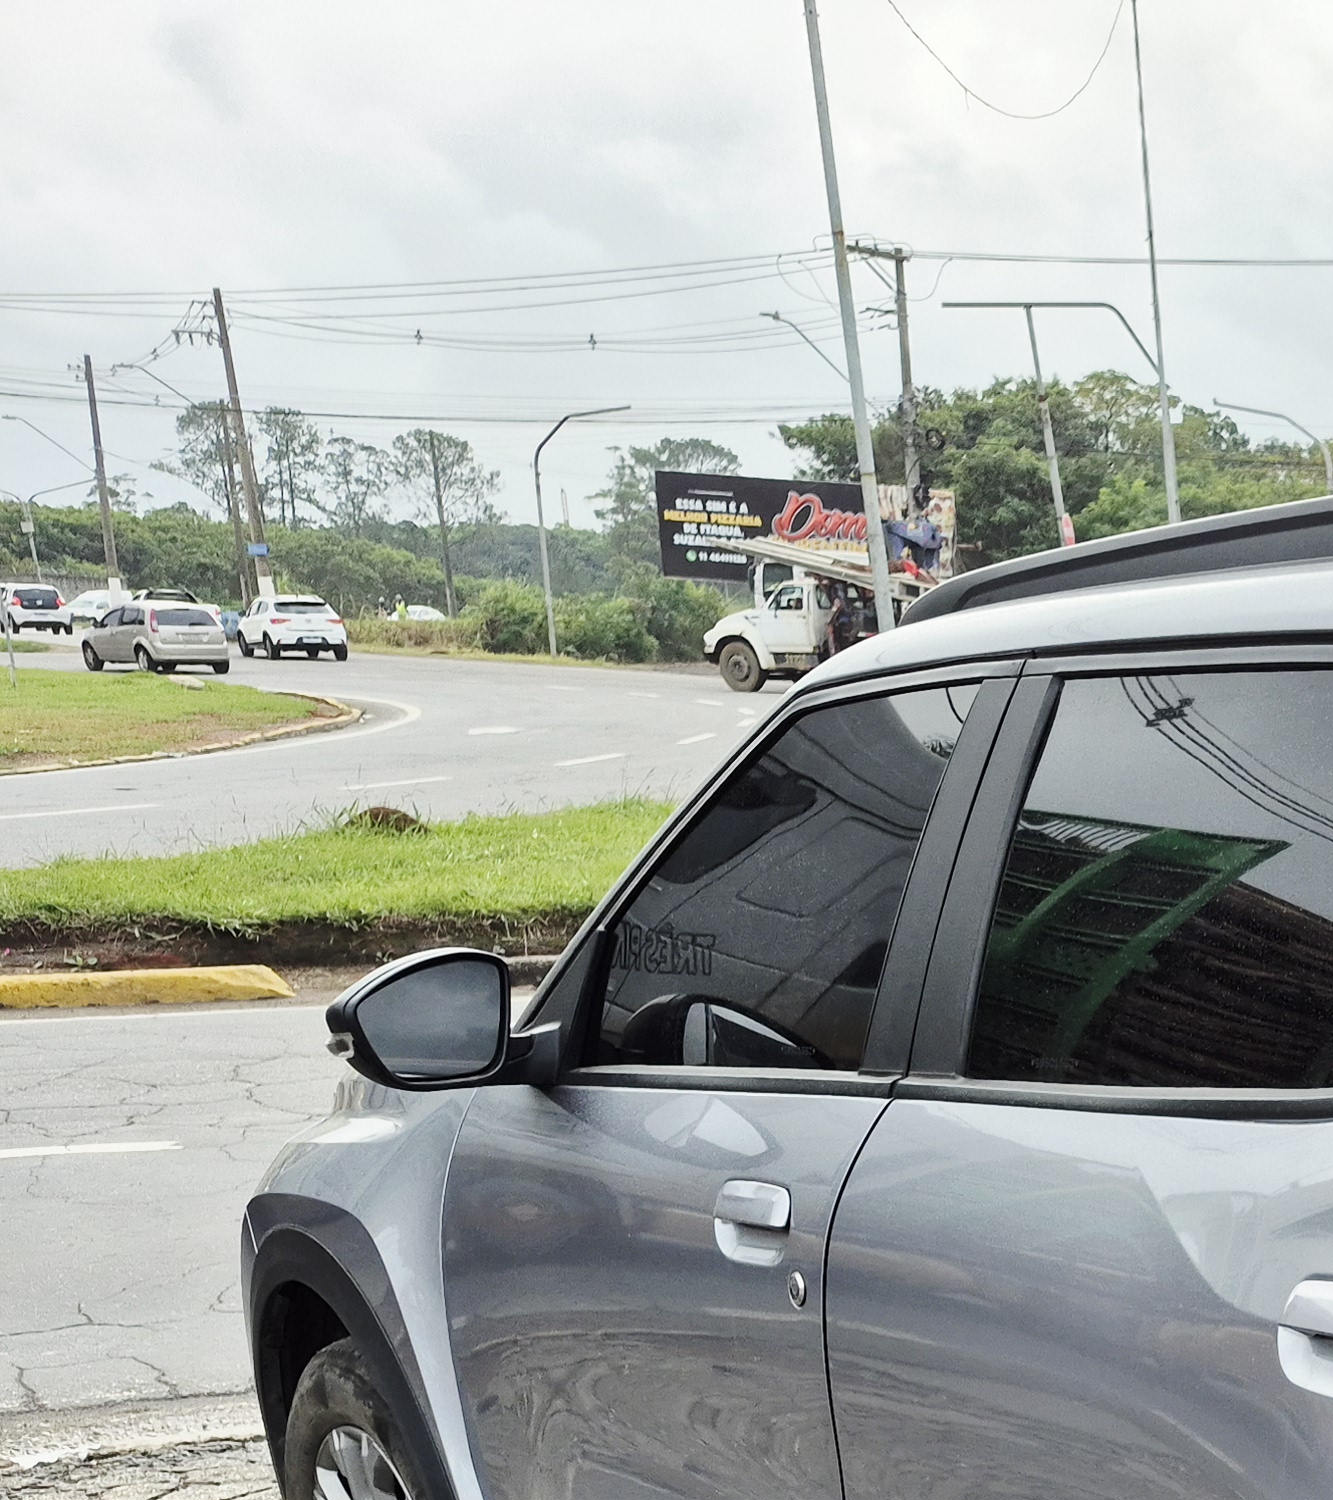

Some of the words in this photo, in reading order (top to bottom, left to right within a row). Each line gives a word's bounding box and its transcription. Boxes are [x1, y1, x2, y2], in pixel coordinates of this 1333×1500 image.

[675, 497, 703, 511] ESSA
[739, 501, 748, 514] A
[663, 508, 708, 523] MELHOR
[710, 512, 763, 528] PIZZARIA
[683, 522, 698, 534] DE
